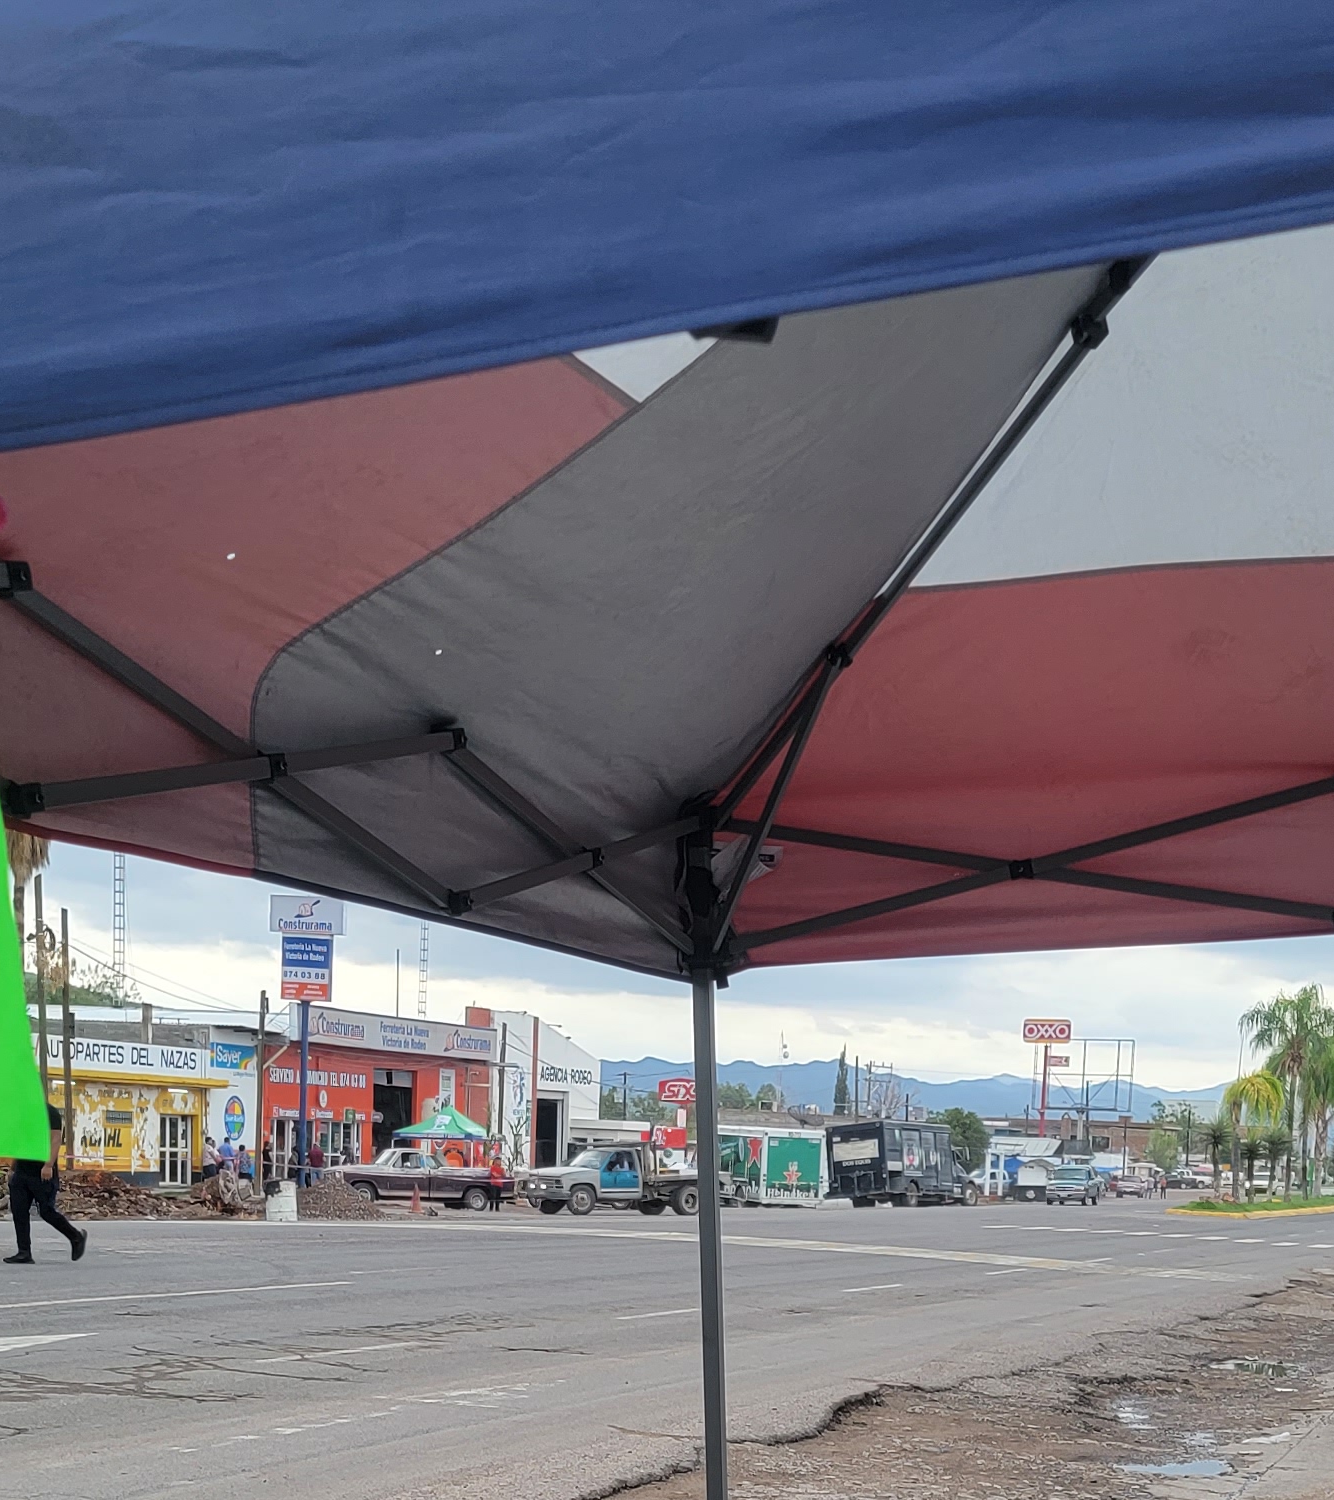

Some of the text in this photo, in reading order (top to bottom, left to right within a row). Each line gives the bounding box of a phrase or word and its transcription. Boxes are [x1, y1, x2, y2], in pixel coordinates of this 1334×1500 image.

[278, 918, 333, 931] Construrama
[301, 971, 312, 979] 03
[321, 1016, 365, 1038] Construrama
[406, 1024, 413, 1035] La
[1024, 1024, 1069, 1039] OXXO
[382, 1035, 402, 1048] Victoria
[403, 1038, 410, 1049] de
[456, 1033, 491, 1051] Construrama
[131, 1047, 154, 1067] DEL
[161, 1050, 197, 1070] NAZAS
[216, 1044, 242, 1068] Sayer
[269, 1067, 294, 1083] SERVICIO
[540, 1065, 592, 1086] AGENCIA RODEO
